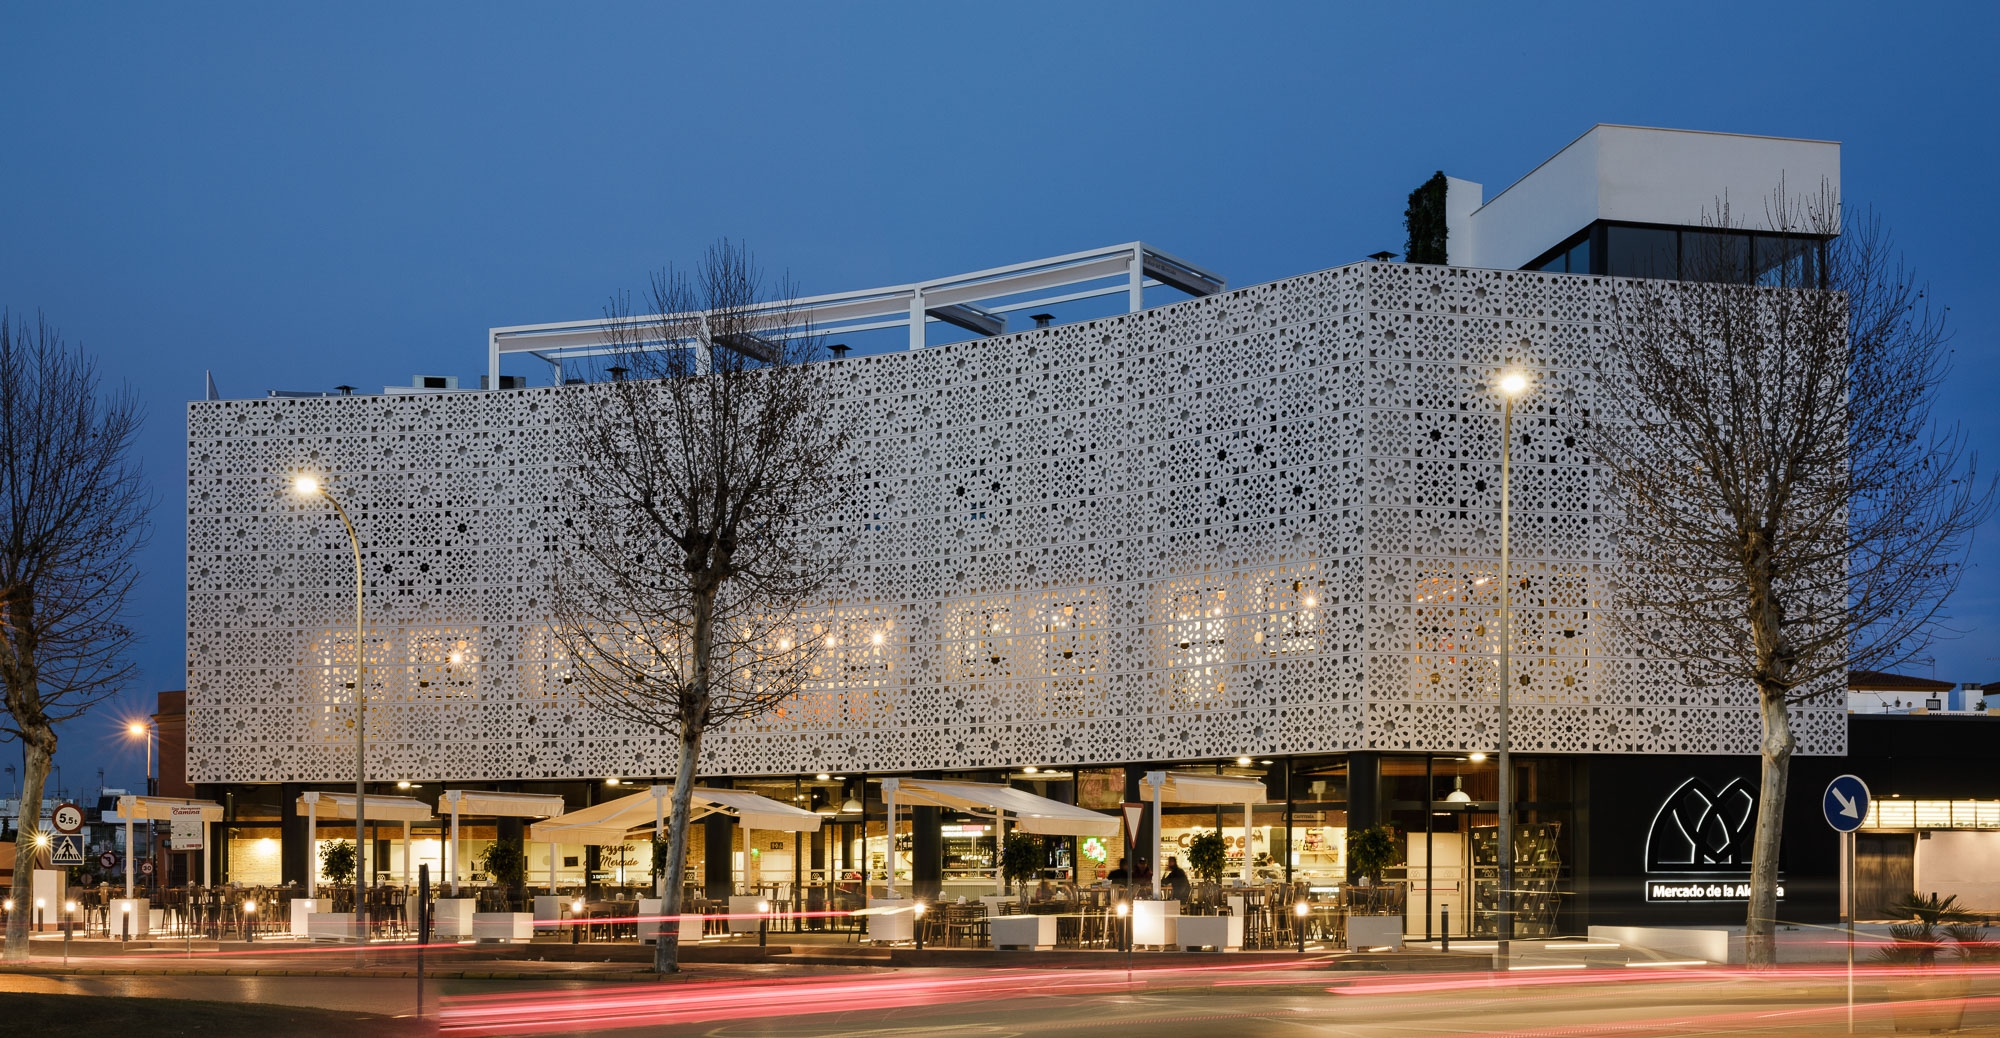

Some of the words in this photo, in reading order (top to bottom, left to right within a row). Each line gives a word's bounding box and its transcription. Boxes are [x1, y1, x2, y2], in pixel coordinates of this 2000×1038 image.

[1177, 832, 1247, 849] Coee
[1653, 884, 1704, 897] Mercado
[1706, 884, 1722, 897] de
[1723, 884, 1734, 897] la
